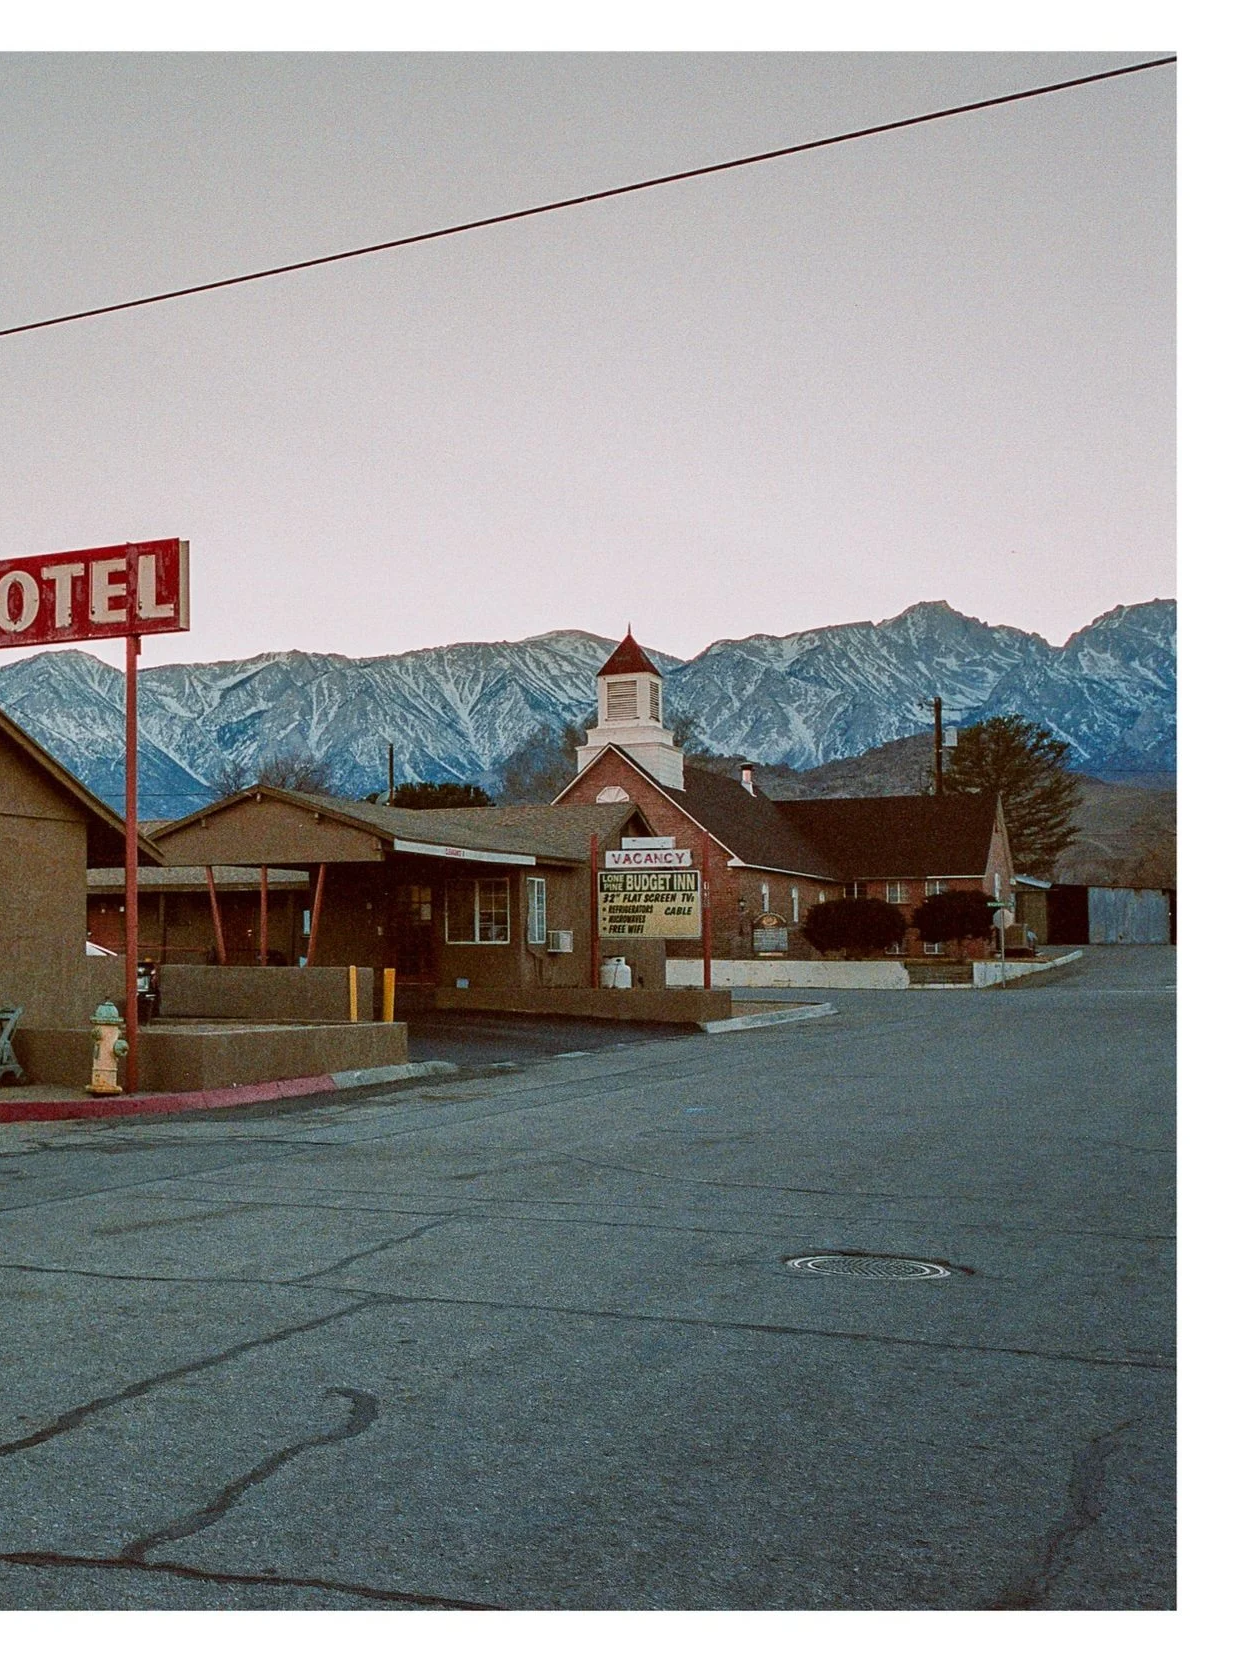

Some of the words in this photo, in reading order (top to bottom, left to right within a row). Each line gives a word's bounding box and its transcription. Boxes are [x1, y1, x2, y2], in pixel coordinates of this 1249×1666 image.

[611, 852, 685, 864] VACANCY
[602, 875, 625, 883] LONE
[626, 874, 672, 891] BUDGET
[673, 874, 695, 891] INN
[603, 883, 624, 891] PINE
[622, 893, 642, 903] FLAT
[643, 893, 677, 903] SCREEN
[608, 905, 654, 914] REFRIGERATORS
[664, 906, 693, 915] CABLE
[608, 915, 646, 924] MICROWAVES
[608, 924, 626, 933] FREE
